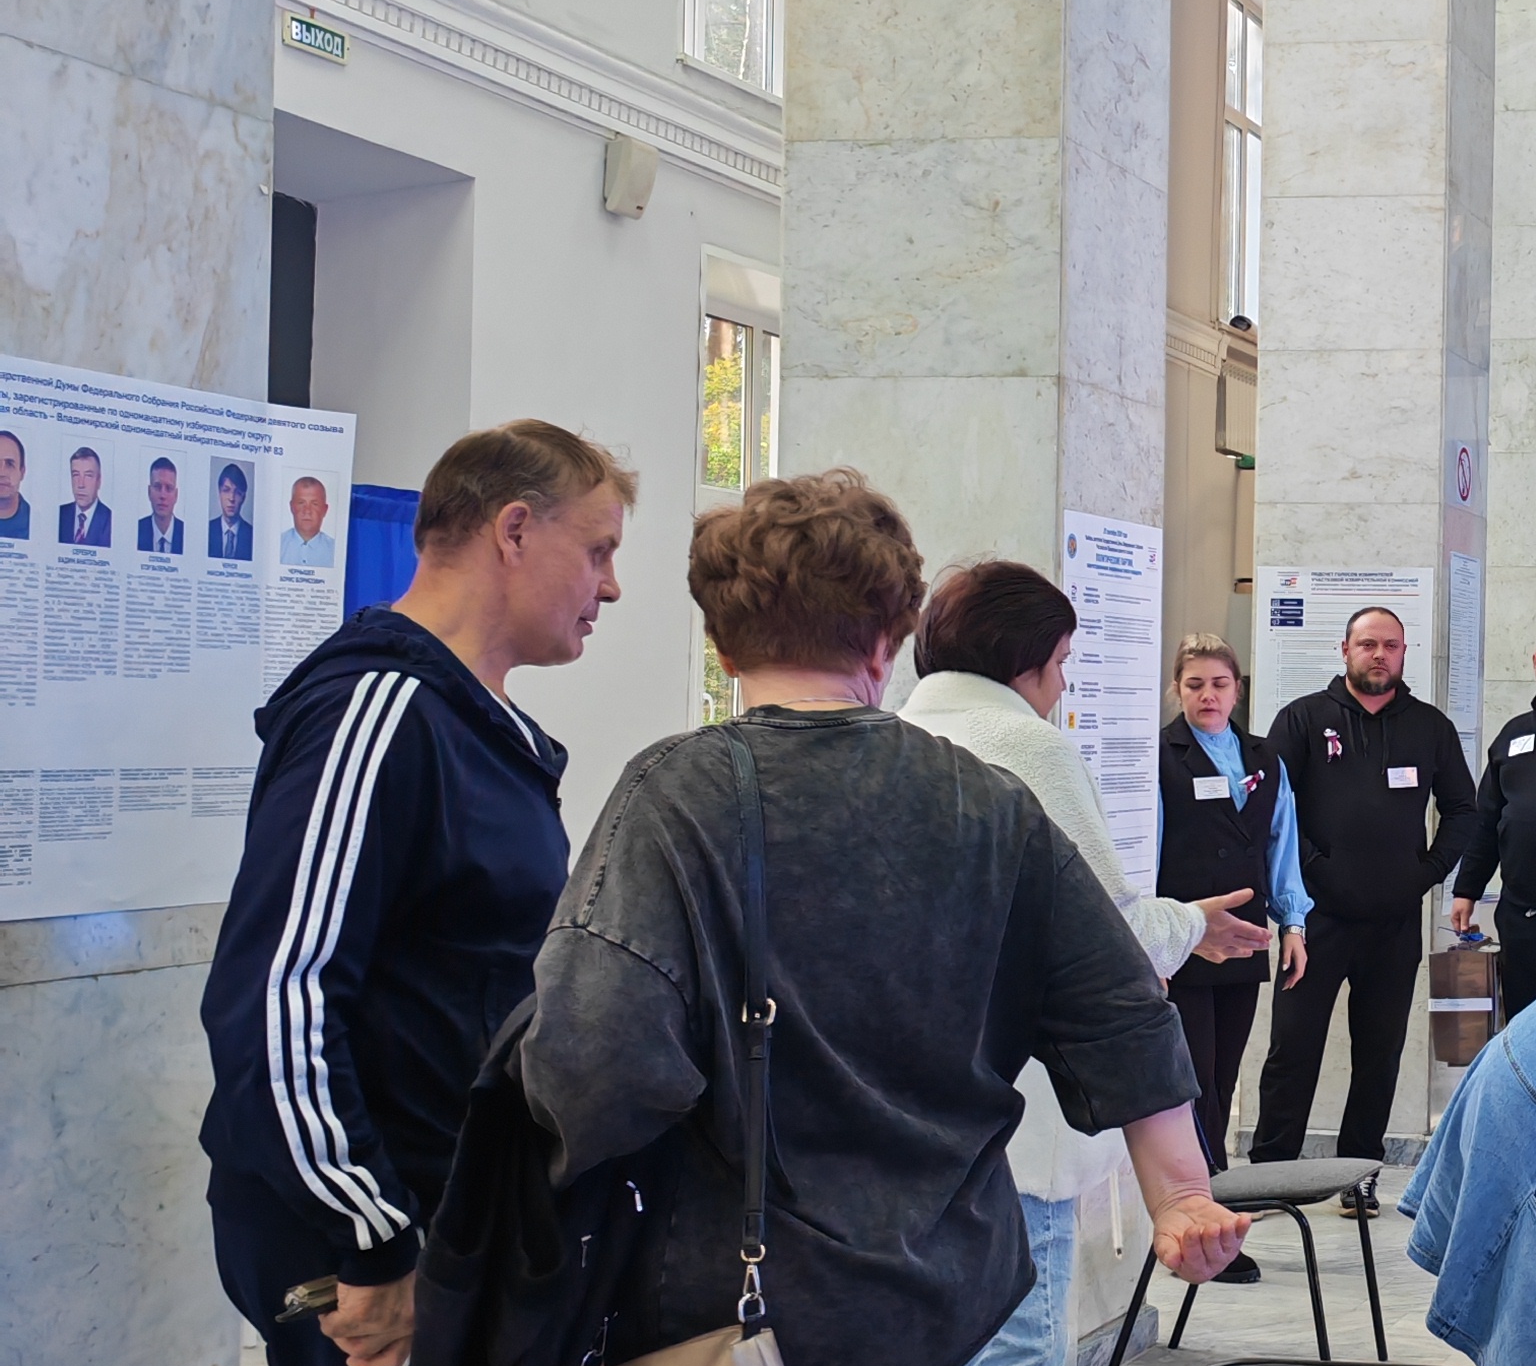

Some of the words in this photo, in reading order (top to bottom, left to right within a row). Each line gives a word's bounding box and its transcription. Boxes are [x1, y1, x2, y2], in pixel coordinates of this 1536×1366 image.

[291, 20, 343, 58] ВЫХОД
[0, 371, 54, 388] арственной
[54, 379, 79, 392] Думы
[81, 383, 140, 403] Федерального
[141, 394, 180, 410] Собрания
[181, 400, 224, 418] Российской
[225, 409, 267, 424] Федерации
[267, 417, 306, 431] девятого
[307, 423, 345, 434] созыва
[13, 392, 105, 415] зарегистрированные
[119, 410, 185, 430] одномандатному
[186, 420, 247, 440] избирательному
[247, 431, 273, 444] округу
[12, 406, 48, 421] область
[56, 412, 120, 431] Владимирский
[121, 423, 183, 441] одномандатный
[184, 433, 241, 450] избирательный
[241, 443, 262, 455] округ
[273, 446, 284, 456] 83
